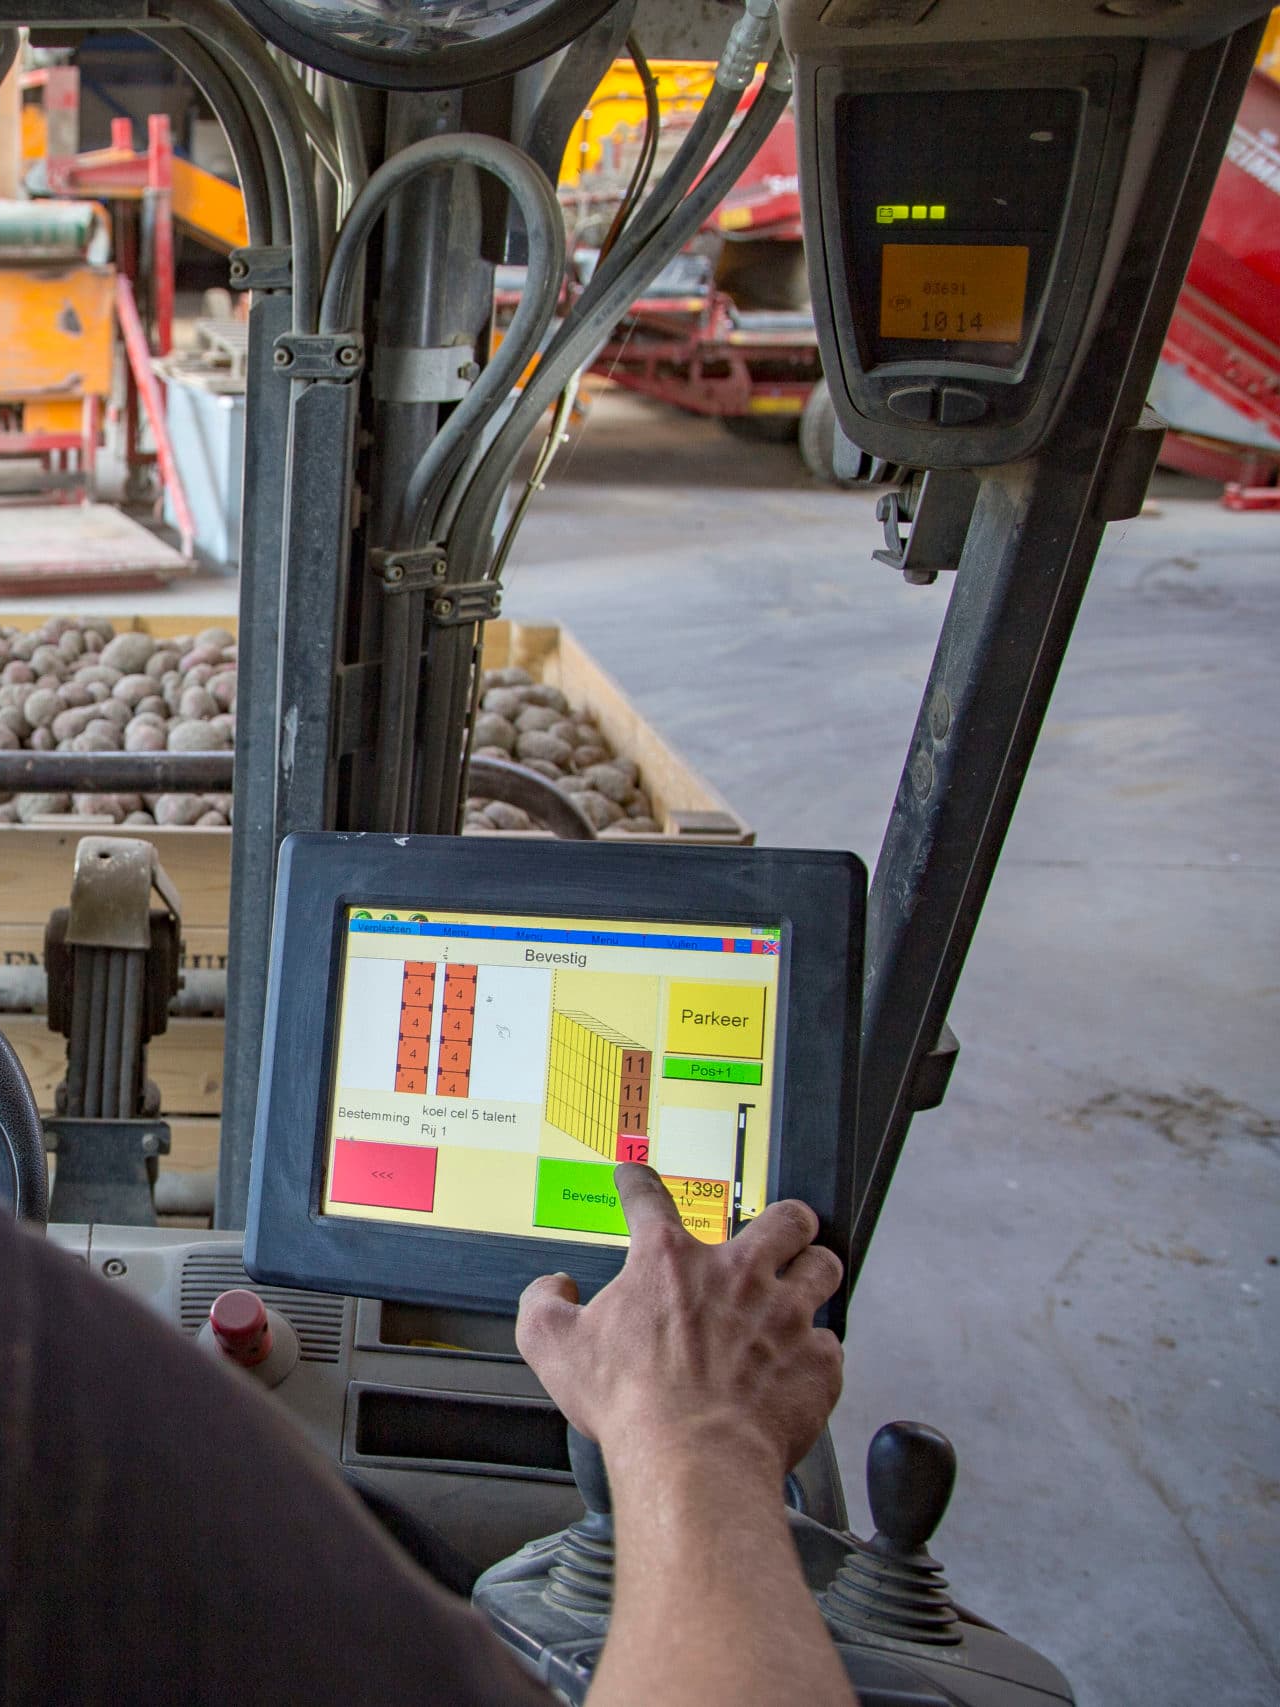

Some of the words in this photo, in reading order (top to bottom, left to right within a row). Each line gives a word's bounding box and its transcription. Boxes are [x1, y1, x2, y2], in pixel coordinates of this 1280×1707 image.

[358, 923, 412, 935] Verplaatsen
[443, 927, 469, 938] Menu
[591, 935, 619, 946] Menu
[525, 948, 587, 967] Bevestig
[415, 987, 422, 997] 4
[455, 989, 463, 999] 4
[412, 1018, 419, 1027] 4
[681, 1008, 749, 1028] Parkeer
[453, 1021, 461, 1030] 4
[409, 1049, 417, 1059] 4
[451, 1052, 458, 1062] 4
[626, 1055, 645, 1073] 11
[690, 1063, 731, 1078] Pos+1
[407, 1080, 414, 1090] 4
[449, 1083, 456, 1093] 4
[624, 1084, 643, 1102] 11
[338, 1106, 410, 1126] Bestemming
[422, 1105, 447, 1117] koel
[450, 1108, 468, 1119] cel
[471, 1109, 479, 1120] 5
[483, 1111, 517, 1124] talent
[622, 1111, 641, 1129] 11
[421, 1124, 437, 1138] Rij
[441, 1126, 447, 1136] 1
[626, 1144, 649, 1162] 12
[682, 1181, 724, 1198] 1399
[562, 1188, 616, 1207] Bevestig
[680, 1216, 710, 1231] olph
